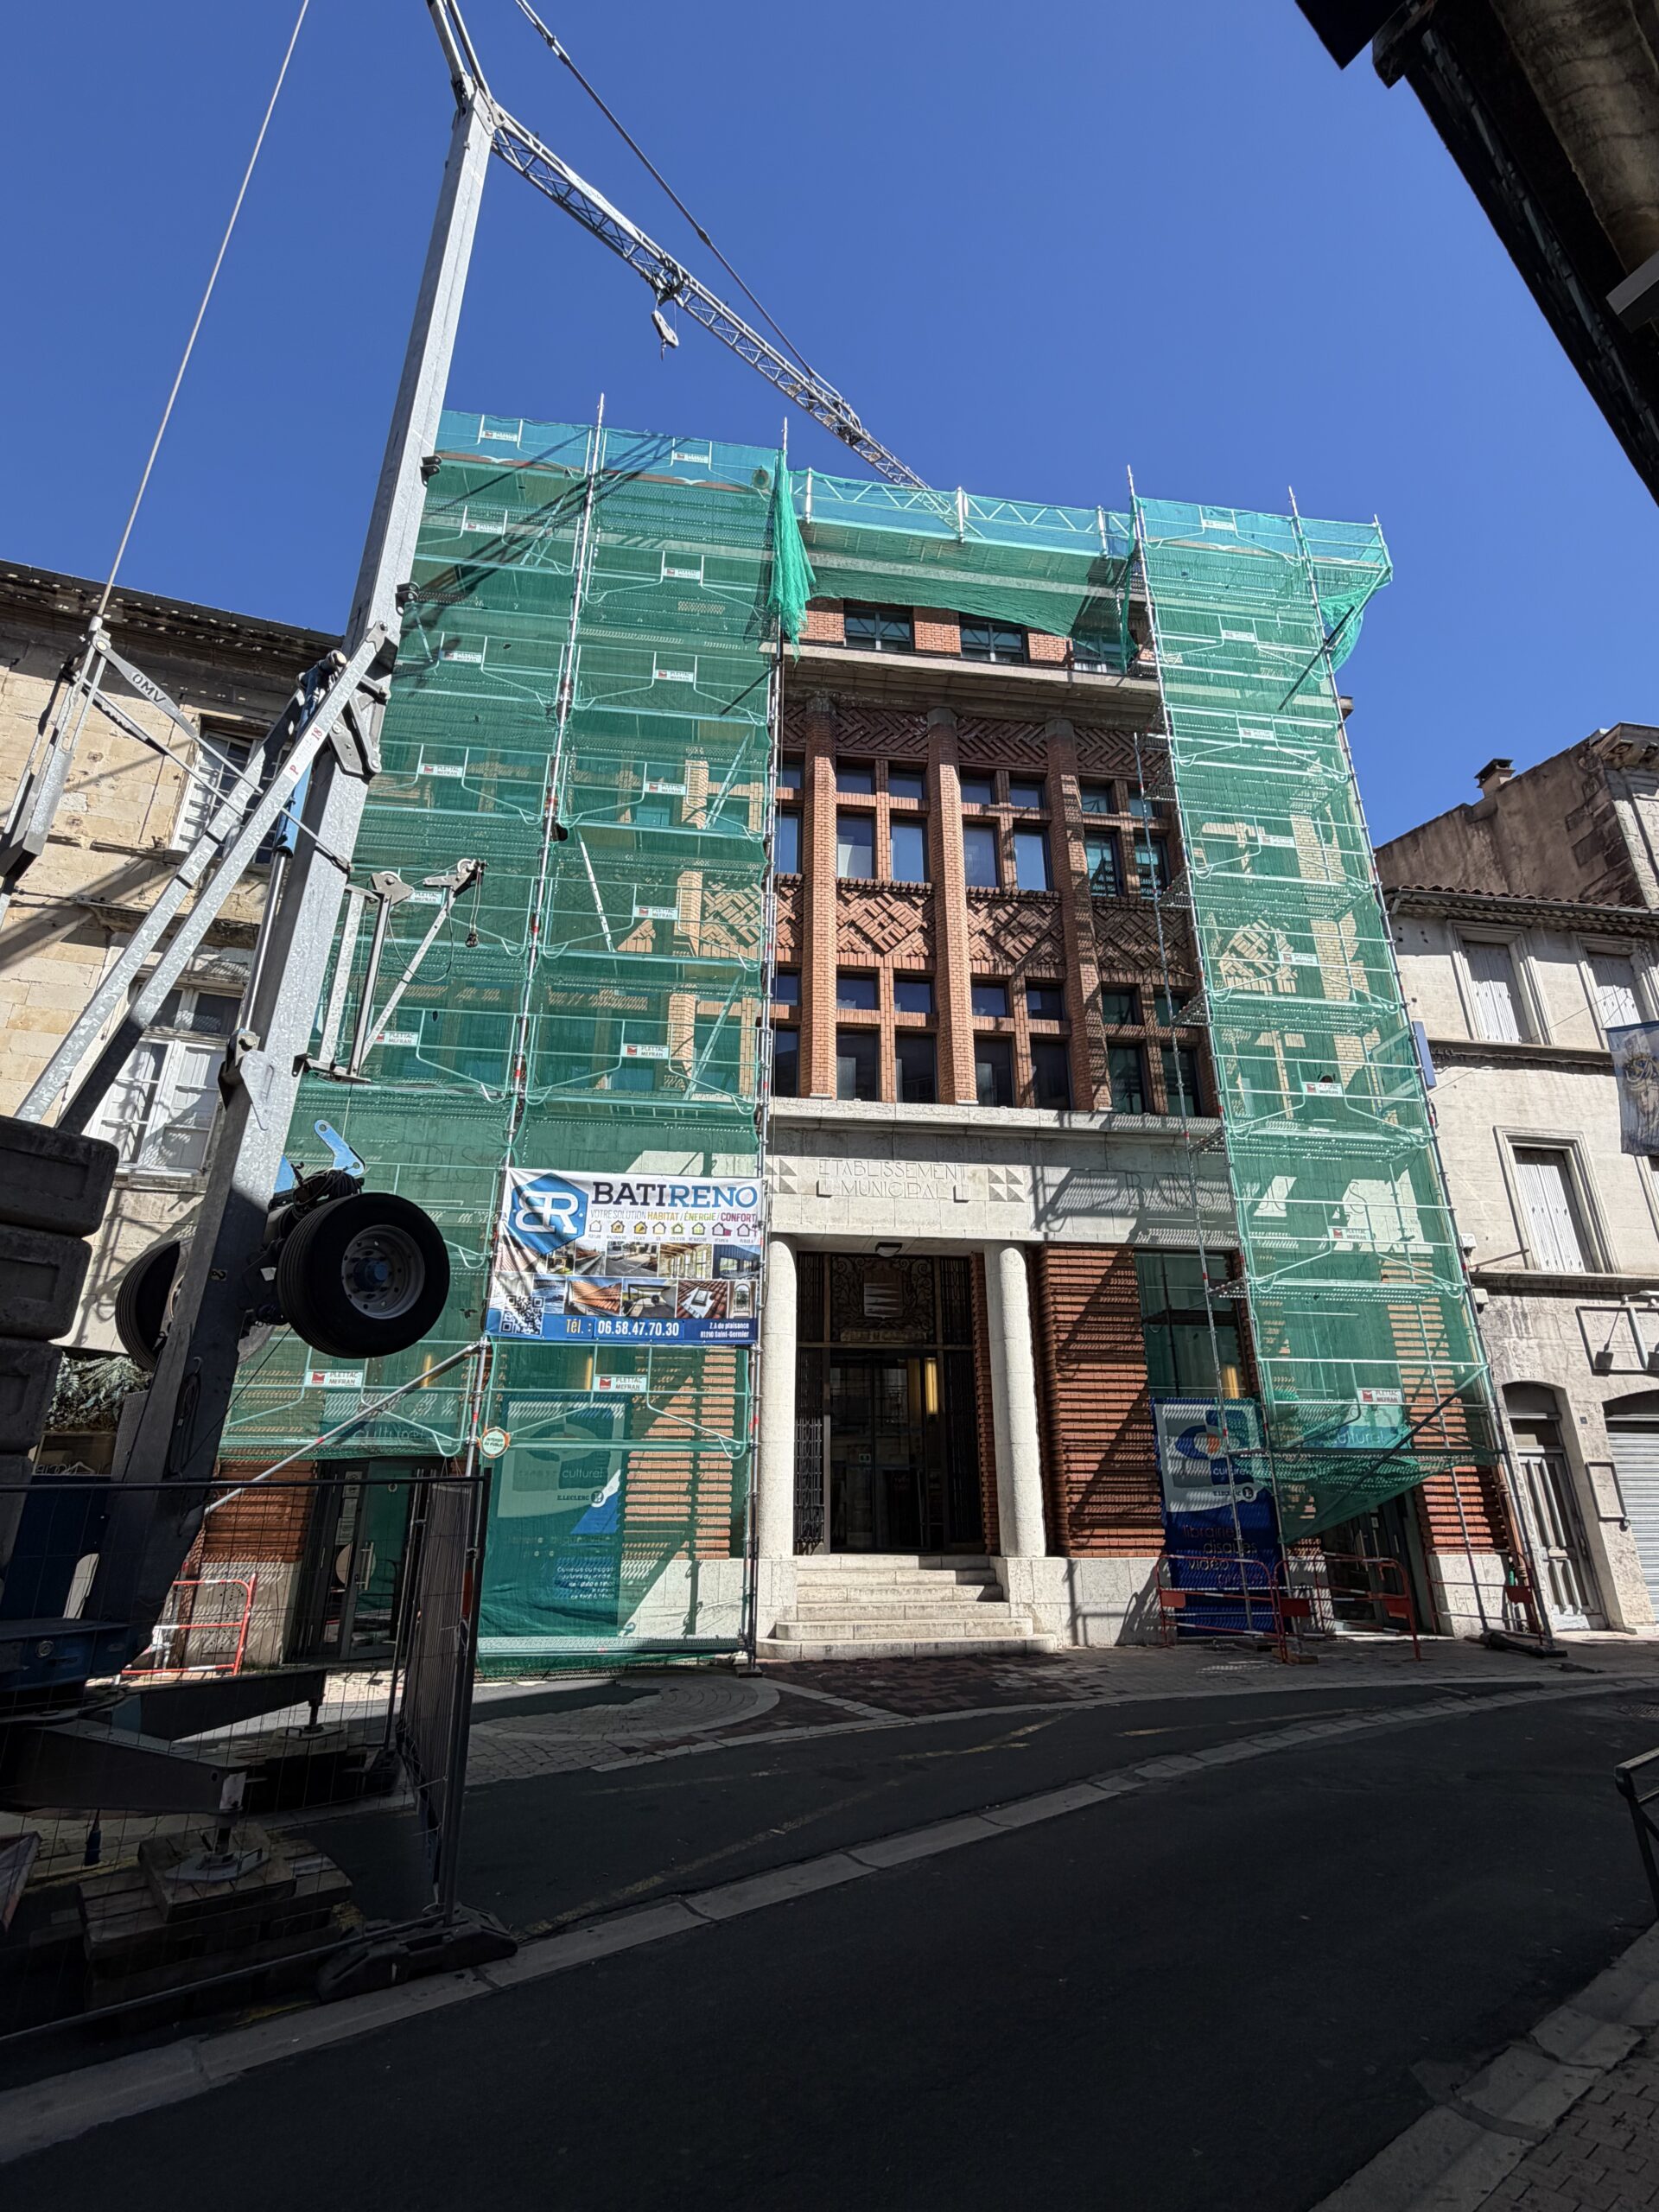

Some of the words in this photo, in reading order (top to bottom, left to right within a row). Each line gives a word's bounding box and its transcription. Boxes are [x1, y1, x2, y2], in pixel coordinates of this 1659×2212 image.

[132, 674, 167, 702] OMV
[311, 727, 323, 741] 18
[818, 1159, 969, 1180] ETABLISSEMENT
[591, 1181, 758, 1209] BATIRENO
[841, 1179, 948, 1200] MUNICIPAL
[590, 1209, 613, 1218] VOTRE
[612, 1210, 646, 1220] SOLUTION
[647, 1211, 679, 1221] HABITAT
[684, 1211, 715, 1222] ÉNERGIE
[720, 1212, 756, 1223] CONFORT
[566, 1319, 584, 1334] Tél.
[597, 1320, 680, 1336] 06.58.47.70.30
[725, 1322, 750, 1331] plaisance
[563, 1468, 603, 1478] culturel
[1182, 1524, 1235, 1538] librairie
[1203, 1540, 1257, 1554] disques
